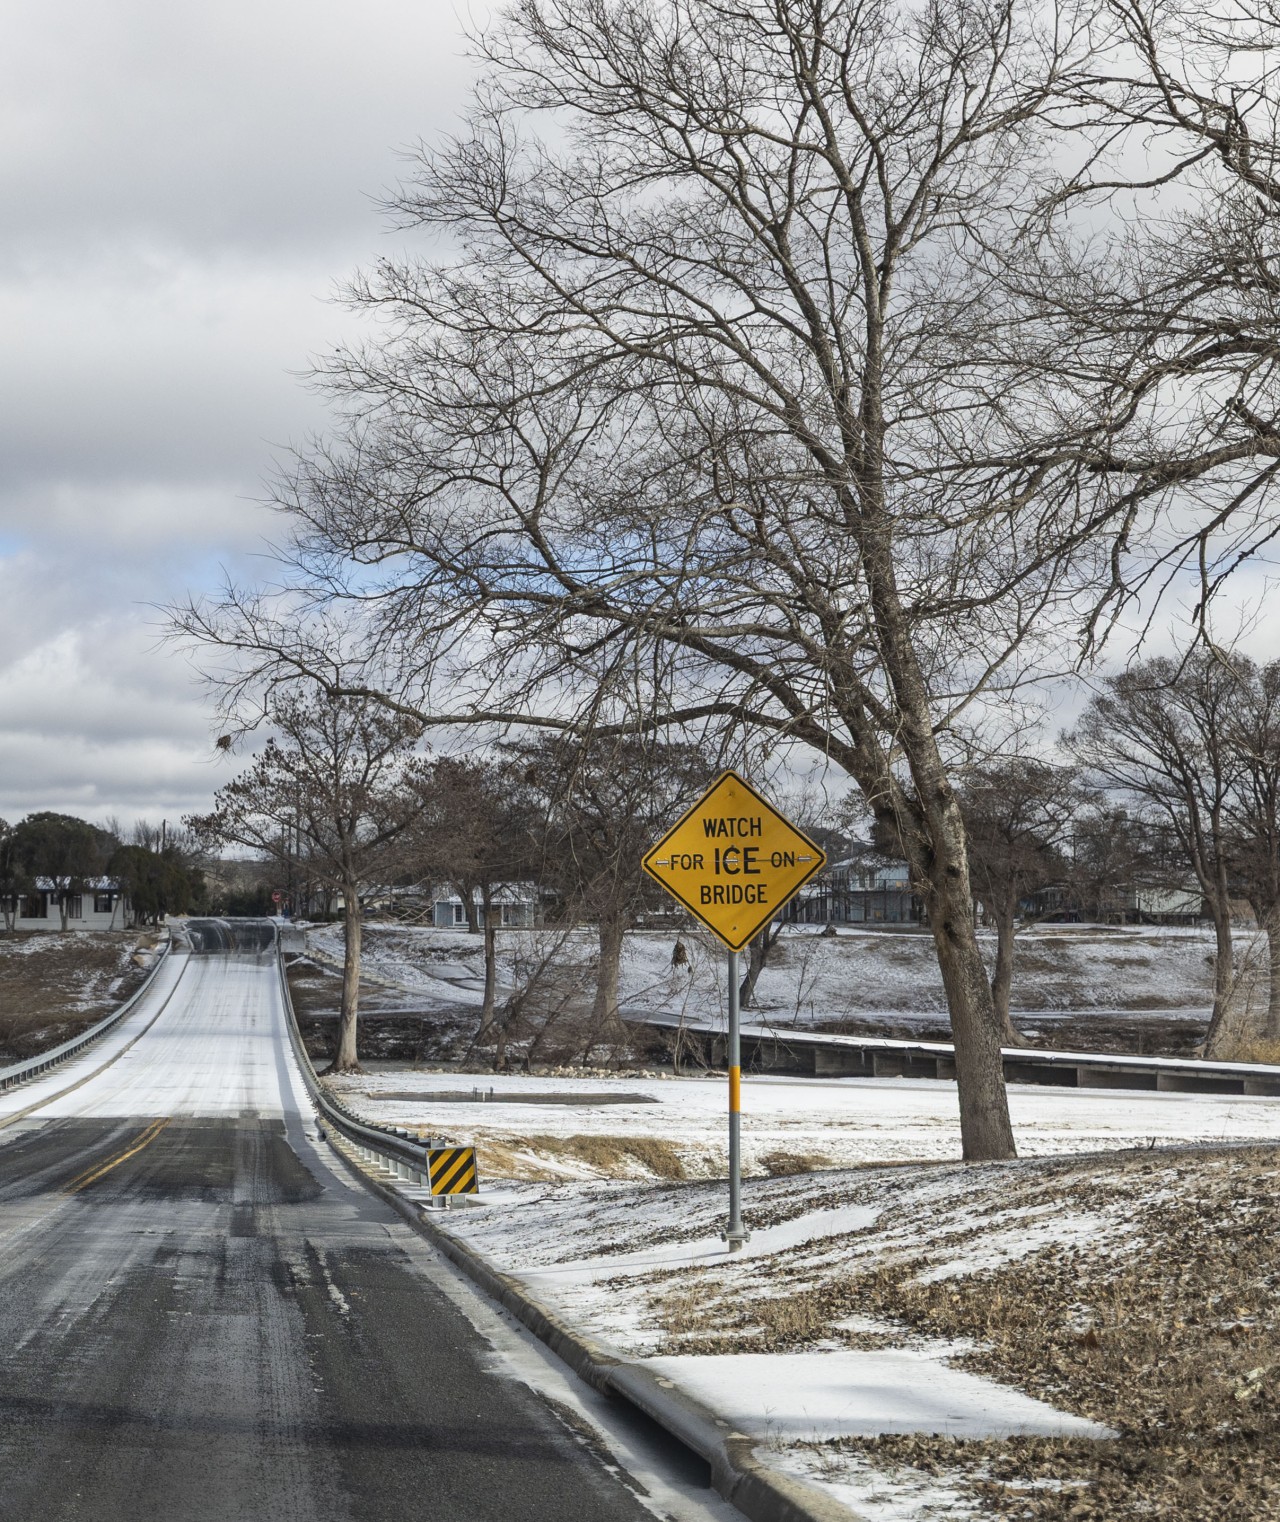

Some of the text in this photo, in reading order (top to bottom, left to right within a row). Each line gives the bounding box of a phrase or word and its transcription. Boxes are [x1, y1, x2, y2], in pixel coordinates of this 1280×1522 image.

[702, 817, 762, 838] WATCH
[670, 846, 796, 875] FOR ICE ON
[700, 884, 769, 905] BRIDGE
